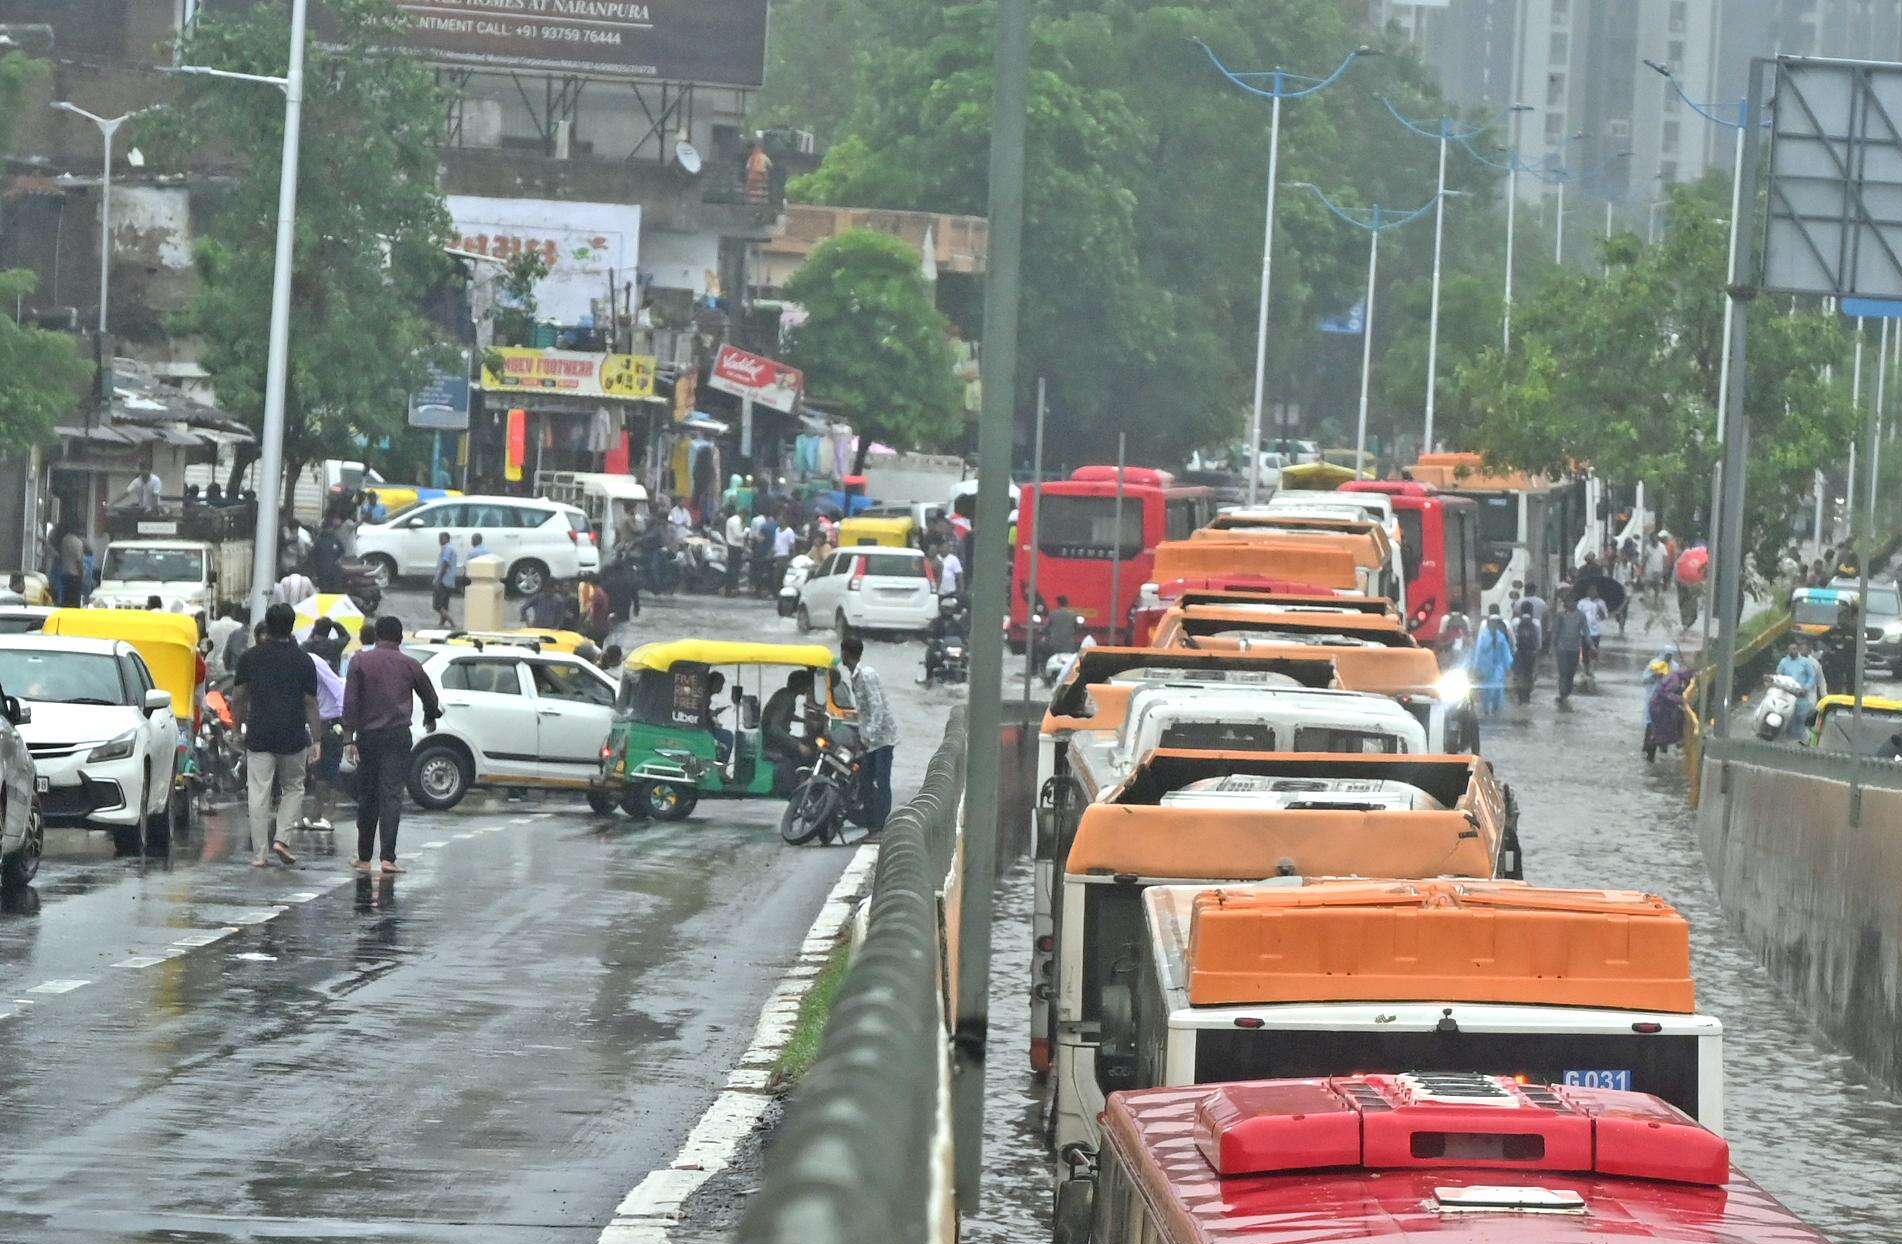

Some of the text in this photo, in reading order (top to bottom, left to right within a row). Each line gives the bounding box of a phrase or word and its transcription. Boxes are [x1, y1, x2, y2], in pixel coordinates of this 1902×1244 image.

[553, 0, 650, 20] NARANPURA
[516, 25, 536, 40] +91
[541, 27, 579, 41] 93759
[583, 29, 622, 44] 76444
[672, 710, 699, 724] Uber
